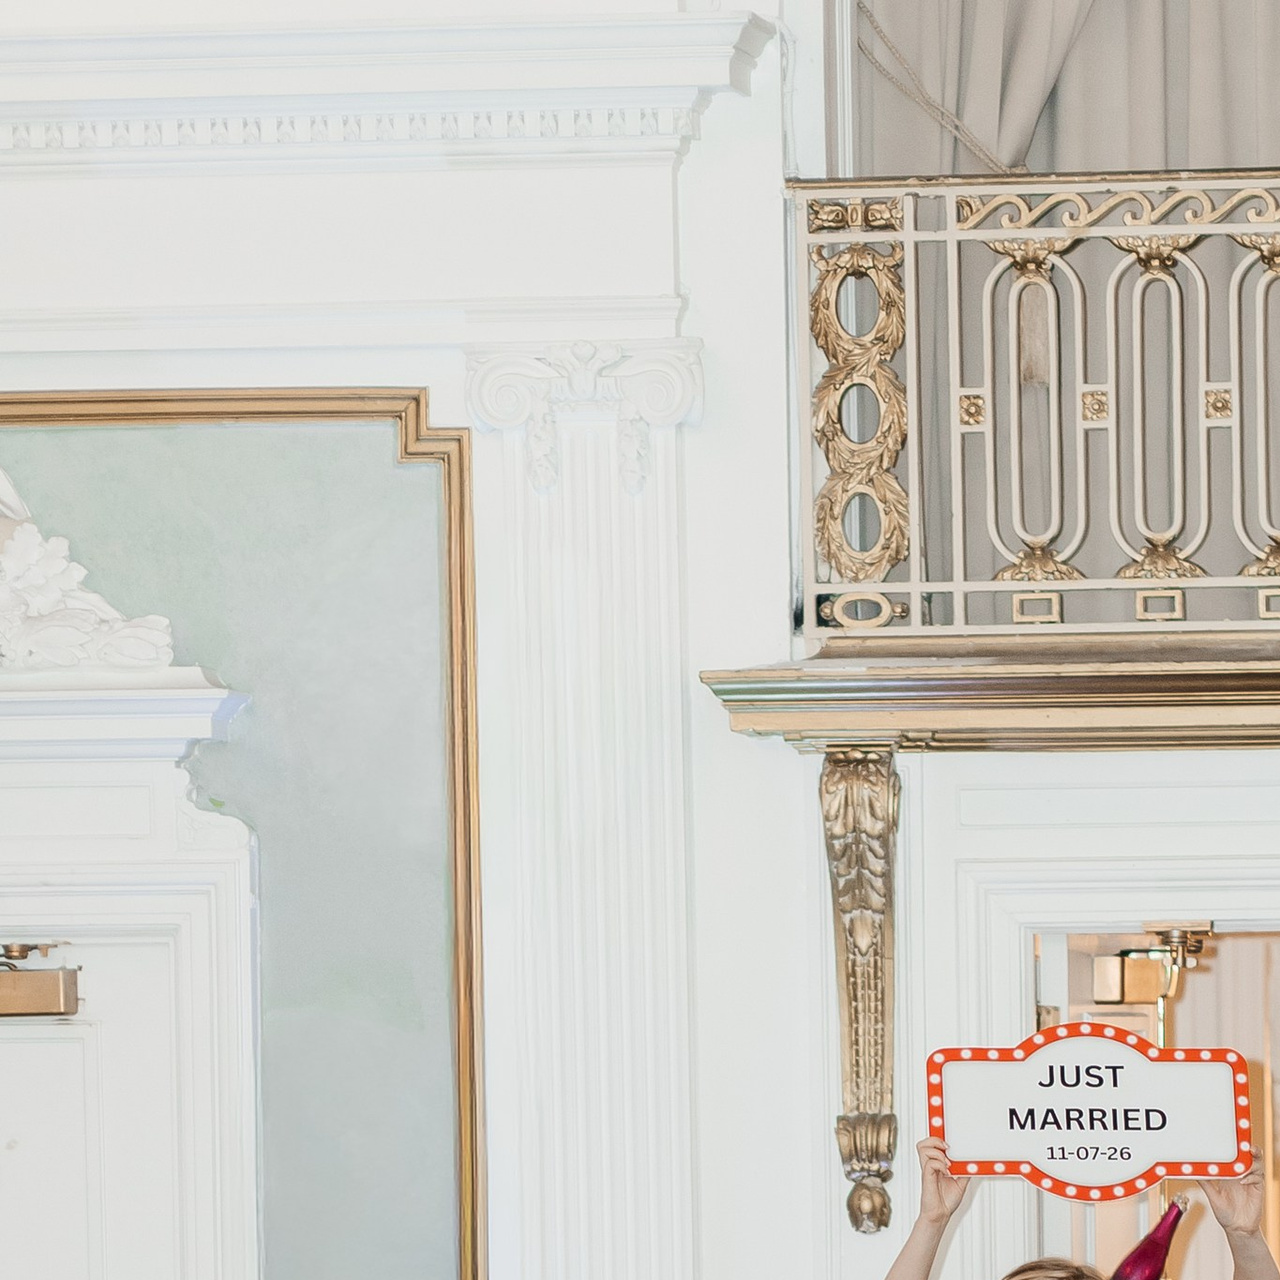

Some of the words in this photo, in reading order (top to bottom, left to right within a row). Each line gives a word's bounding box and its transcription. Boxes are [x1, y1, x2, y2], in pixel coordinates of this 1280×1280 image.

[1038, 1065, 1124, 1088] JUST
[1008, 1108, 1168, 1131] MARRIED
[1047, 1146, 1132, 1160] 11-07-26
